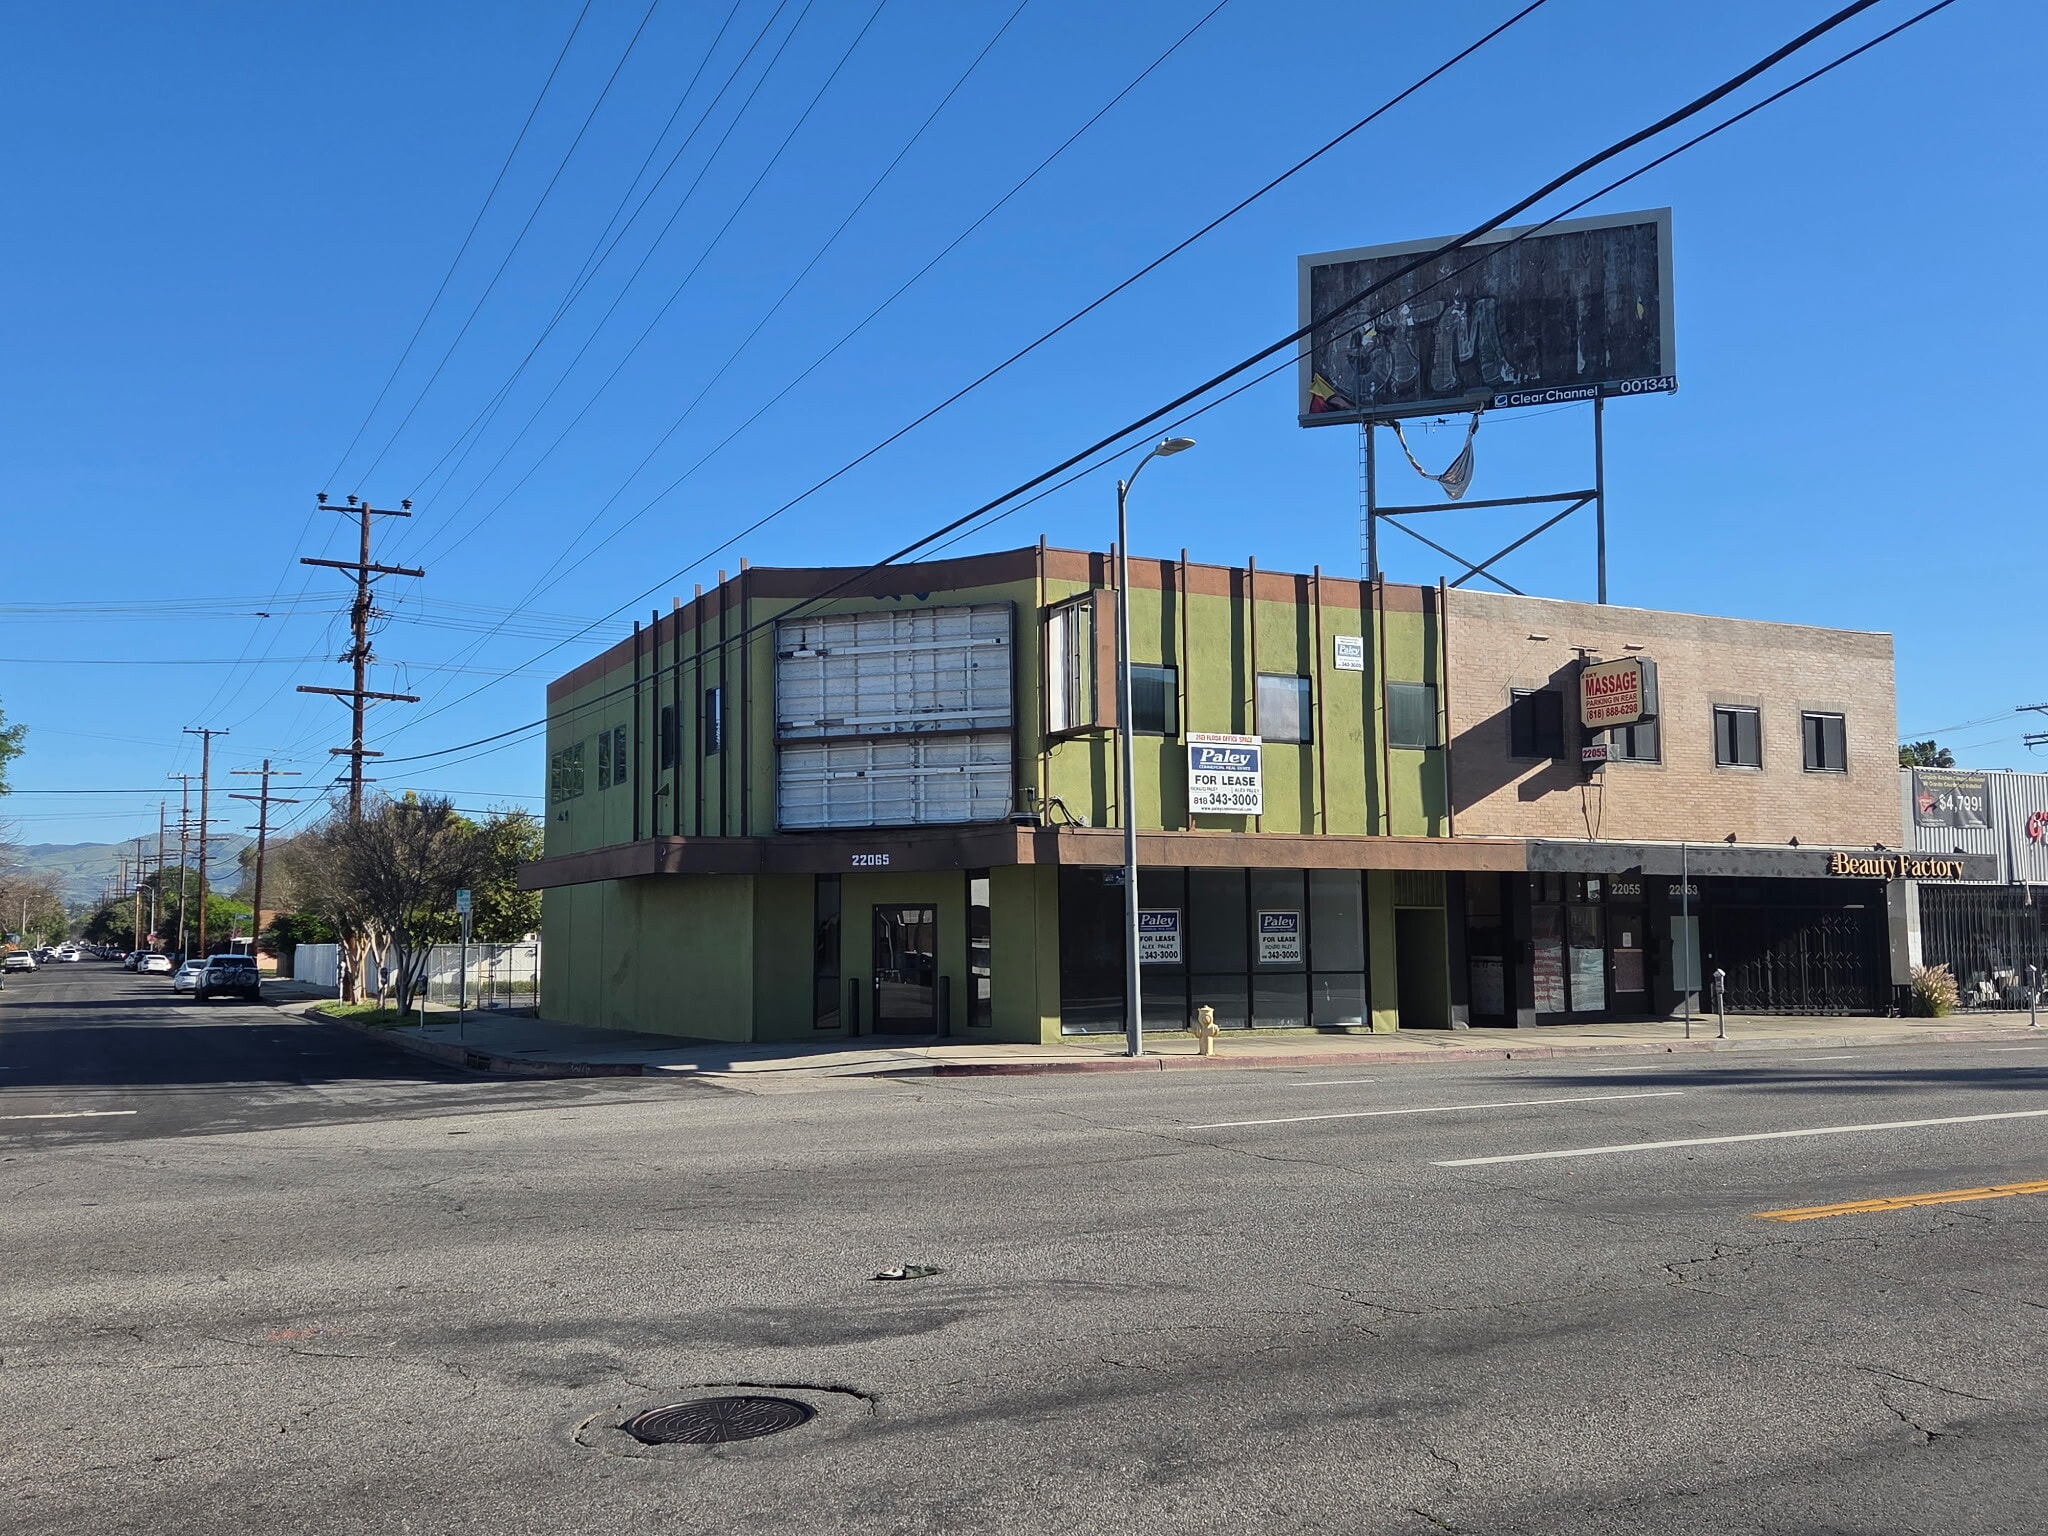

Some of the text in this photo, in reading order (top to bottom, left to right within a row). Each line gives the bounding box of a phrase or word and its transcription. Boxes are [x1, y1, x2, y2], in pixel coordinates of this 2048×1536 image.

[1621, 377, 1675, 393] 001341
[1511, 386, 1598, 405] Clear Channel
[1585, 671, 1637, 697] MASSAGE
[1586, 693, 1638, 707] PARKING IN REAR
[1586, 709, 1605, 722] (818)
[1200, 748, 1251, 766] Paley
[1582, 748, 1607, 759] 22055
[1195, 775, 1256, 787] FOR LEASE
[1193, 793, 1259, 806] 818 343-3000
[1938, 793, 1983, 813] $4,799!
[851, 854, 889, 866] 22065
[1837, 852, 1964, 881] Beauty Factory
[1611, 883, 1641, 895] 22055
[1141, 914, 1175, 927] Paley
[1264, 915, 1296, 928] Paley
[1144, 950, 1179, 959] 343-3000
[1267, 950, 1299, 959] 343-3000
